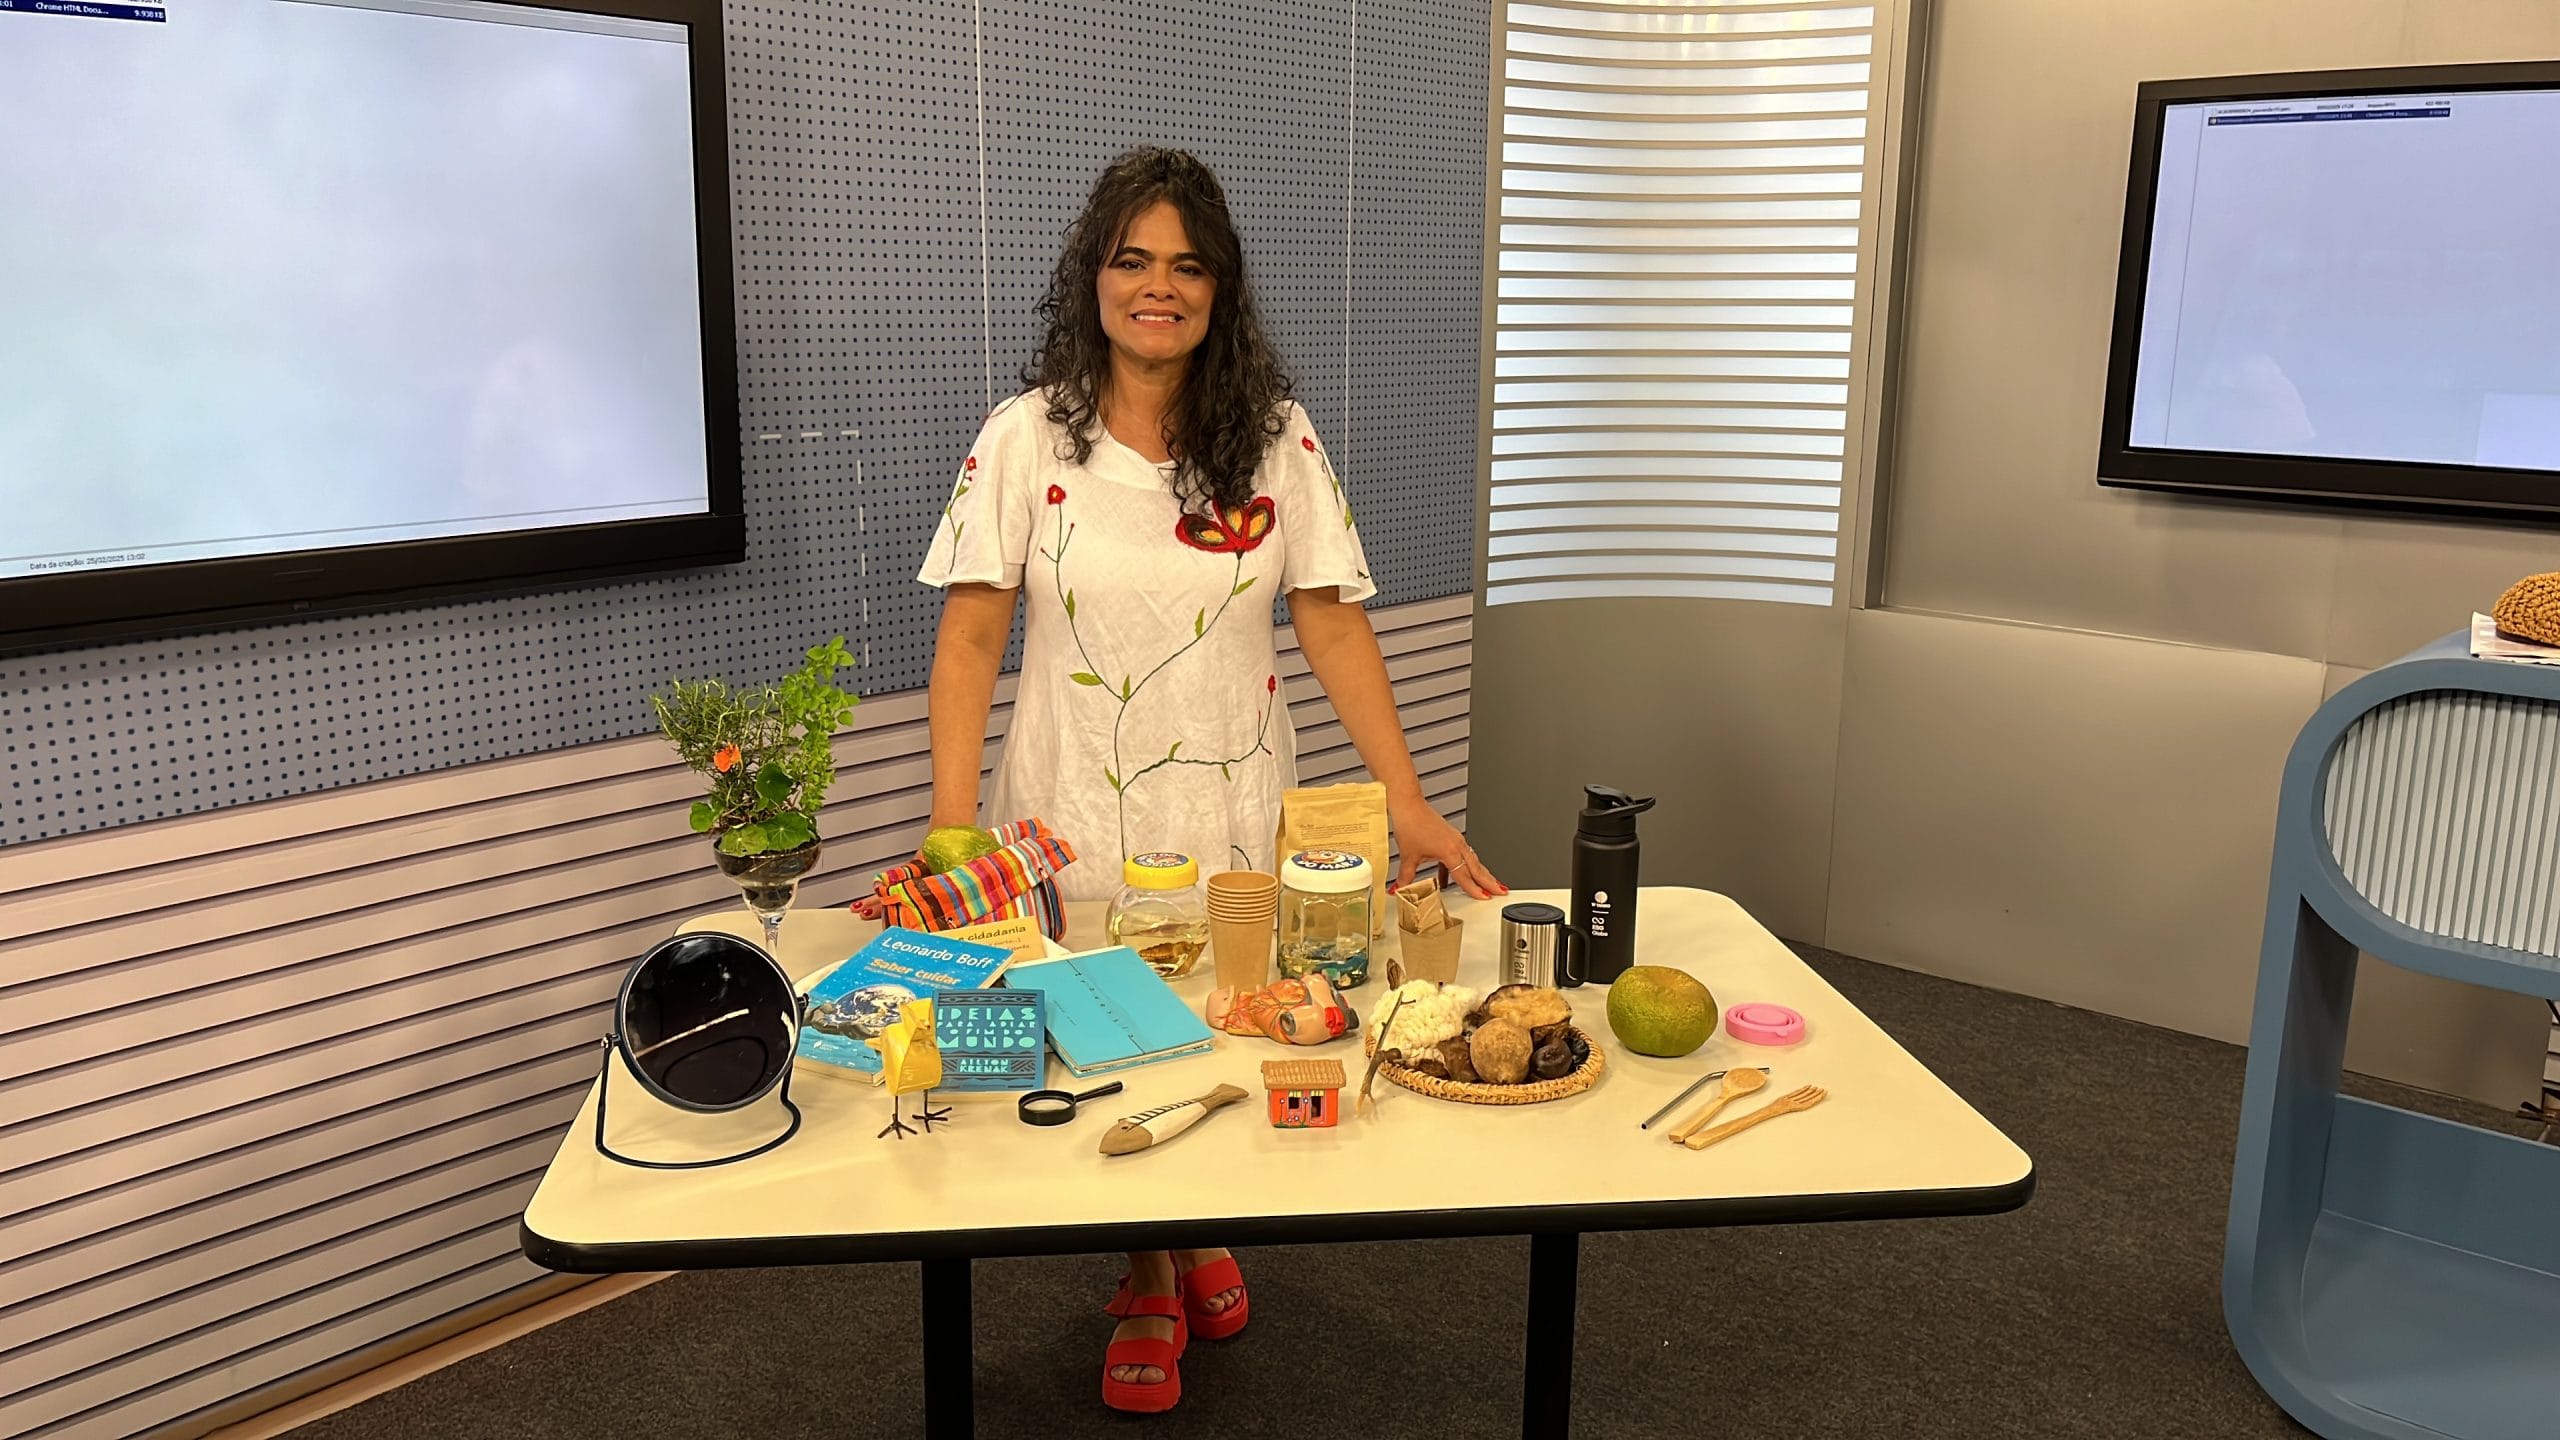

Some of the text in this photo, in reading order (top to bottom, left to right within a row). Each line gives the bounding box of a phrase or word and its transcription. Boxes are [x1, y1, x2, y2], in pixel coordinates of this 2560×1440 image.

[35, 3, 63, 11] Chrome
[63, 5, 82, 13] HTML
[30, 562, 47, 570] Data
[967, 925, 1027, 942] cidadania
[881, 936, 995, 969] Leonardo Boff
[870, 957, 914, 974] Saber
[915, 968, 962, 985] cuidar
[937, 1007, 1037, 1021] IDEIAS
[936, 1020, 1036, 1029] PARA ADIAR
[936, 1035, 1037, 1049] MUNDO
[959, 1058, 1009, 1066] AILTON
[959, 1065, 1009, 1073] KRENAK
